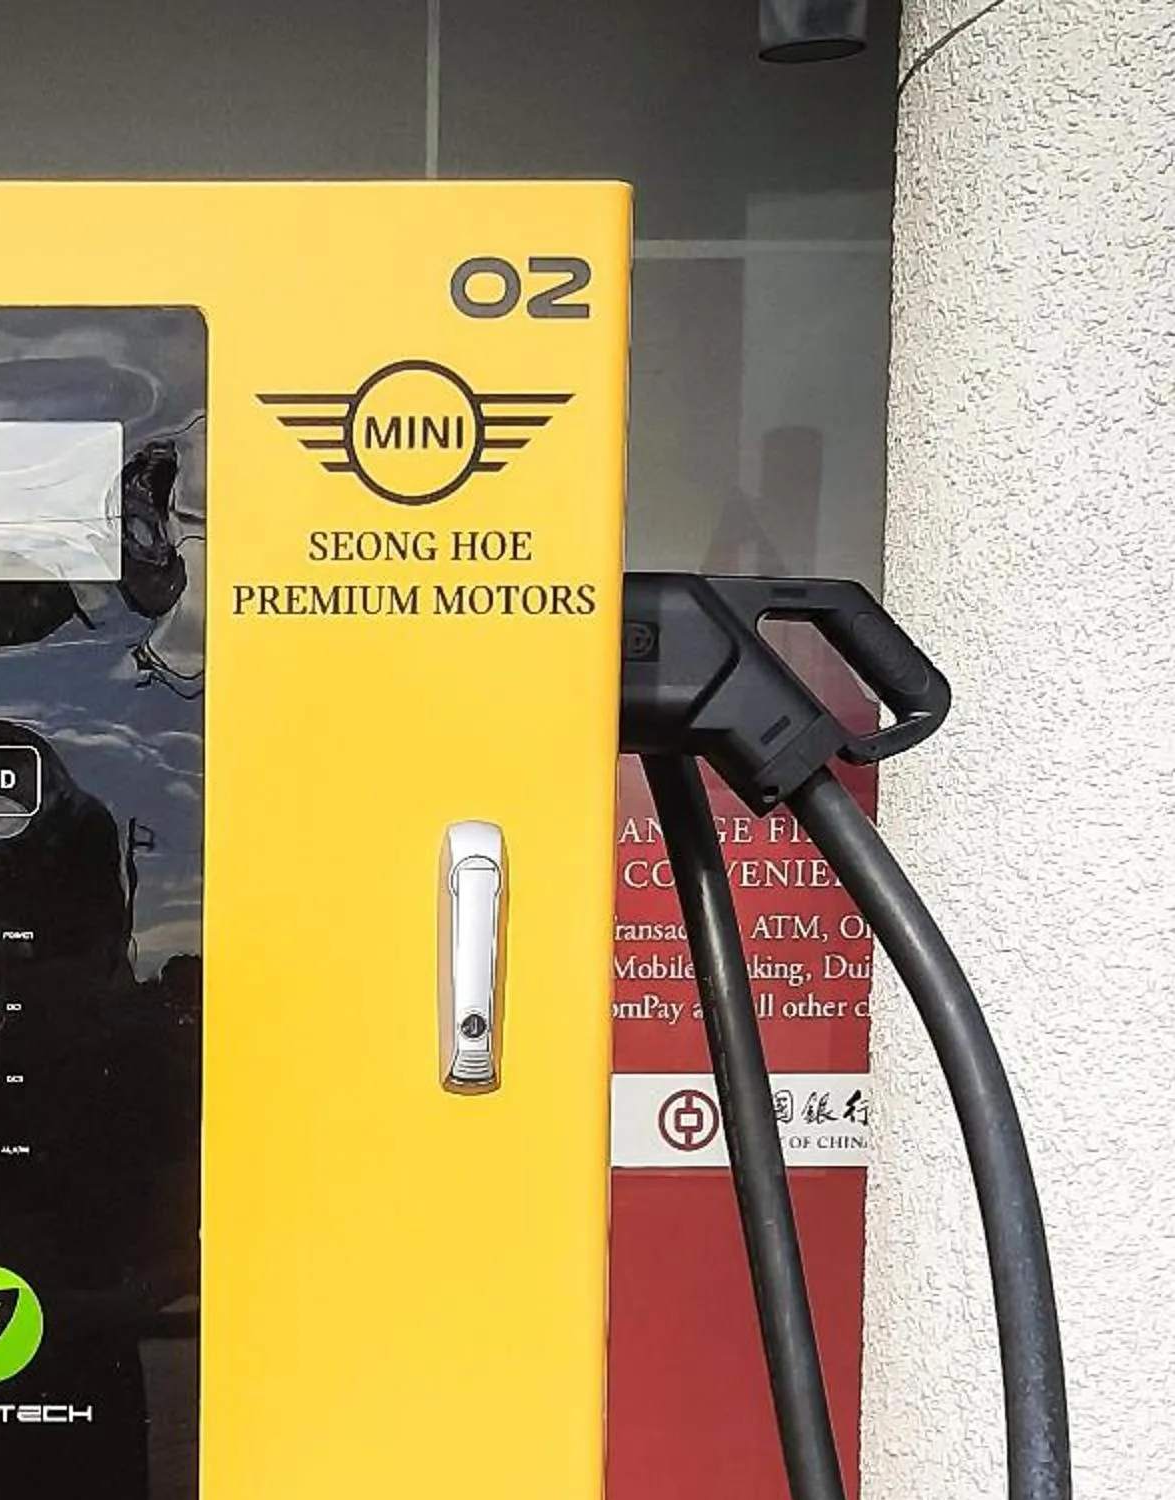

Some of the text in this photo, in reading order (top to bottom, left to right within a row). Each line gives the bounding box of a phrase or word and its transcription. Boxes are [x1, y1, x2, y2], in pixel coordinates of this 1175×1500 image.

[450, 256, 591, 319] 02
[365, 415, 463, 449] MINI
[308, 531, 532, 562] SEONG HOE
[232, 585, 596, 616] PREMIUM MOTORS
[751, 914, 829, 942] ATM,
[782, 991, 847, 1018] other
[789, 1135, 812, 1149] OF
